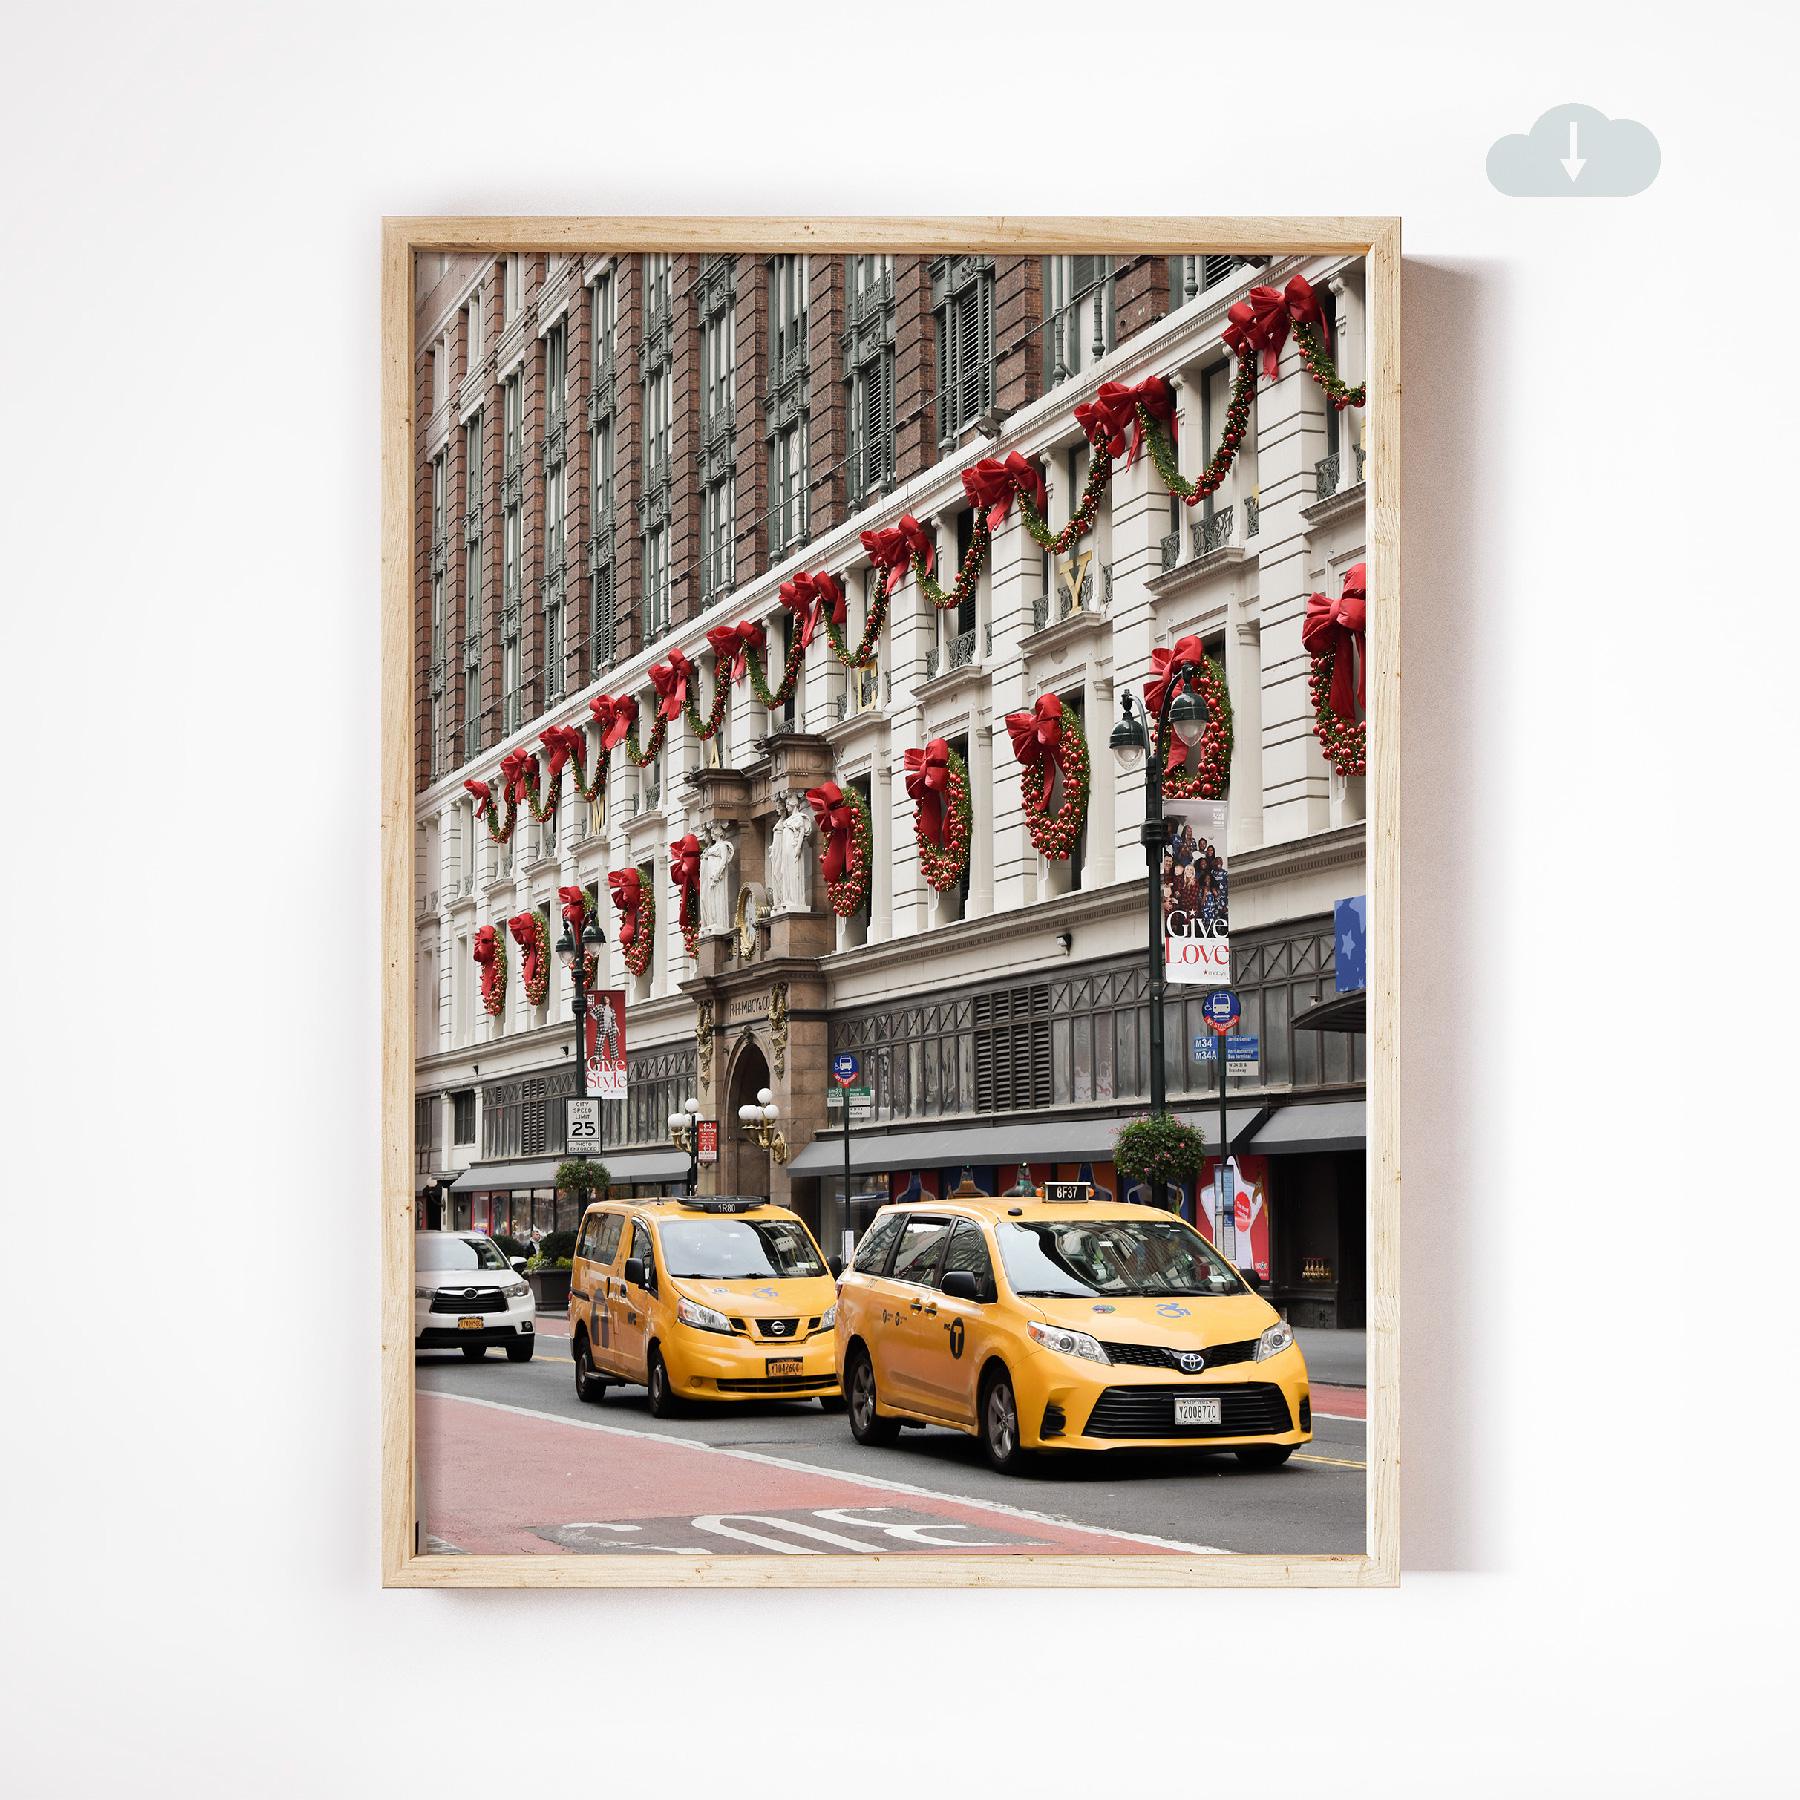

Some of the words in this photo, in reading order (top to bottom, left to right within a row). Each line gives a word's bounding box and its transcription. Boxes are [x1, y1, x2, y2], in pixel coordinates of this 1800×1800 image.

[1059, 549, 1092, 614] Y
[1166, 909, 1229, 939] Give
[1165, 937, 1229, 965] Love
[1195, 1038, 1212, 1048] M34
[587, 1055, 626, 1073] Give
[1195, 1050, 1217, 1060] M34A
[586, 1072, 628, 1092] Style
[572, 1122, 596, 1136] 25
[718, 1203, 736, 1213] 1R80
